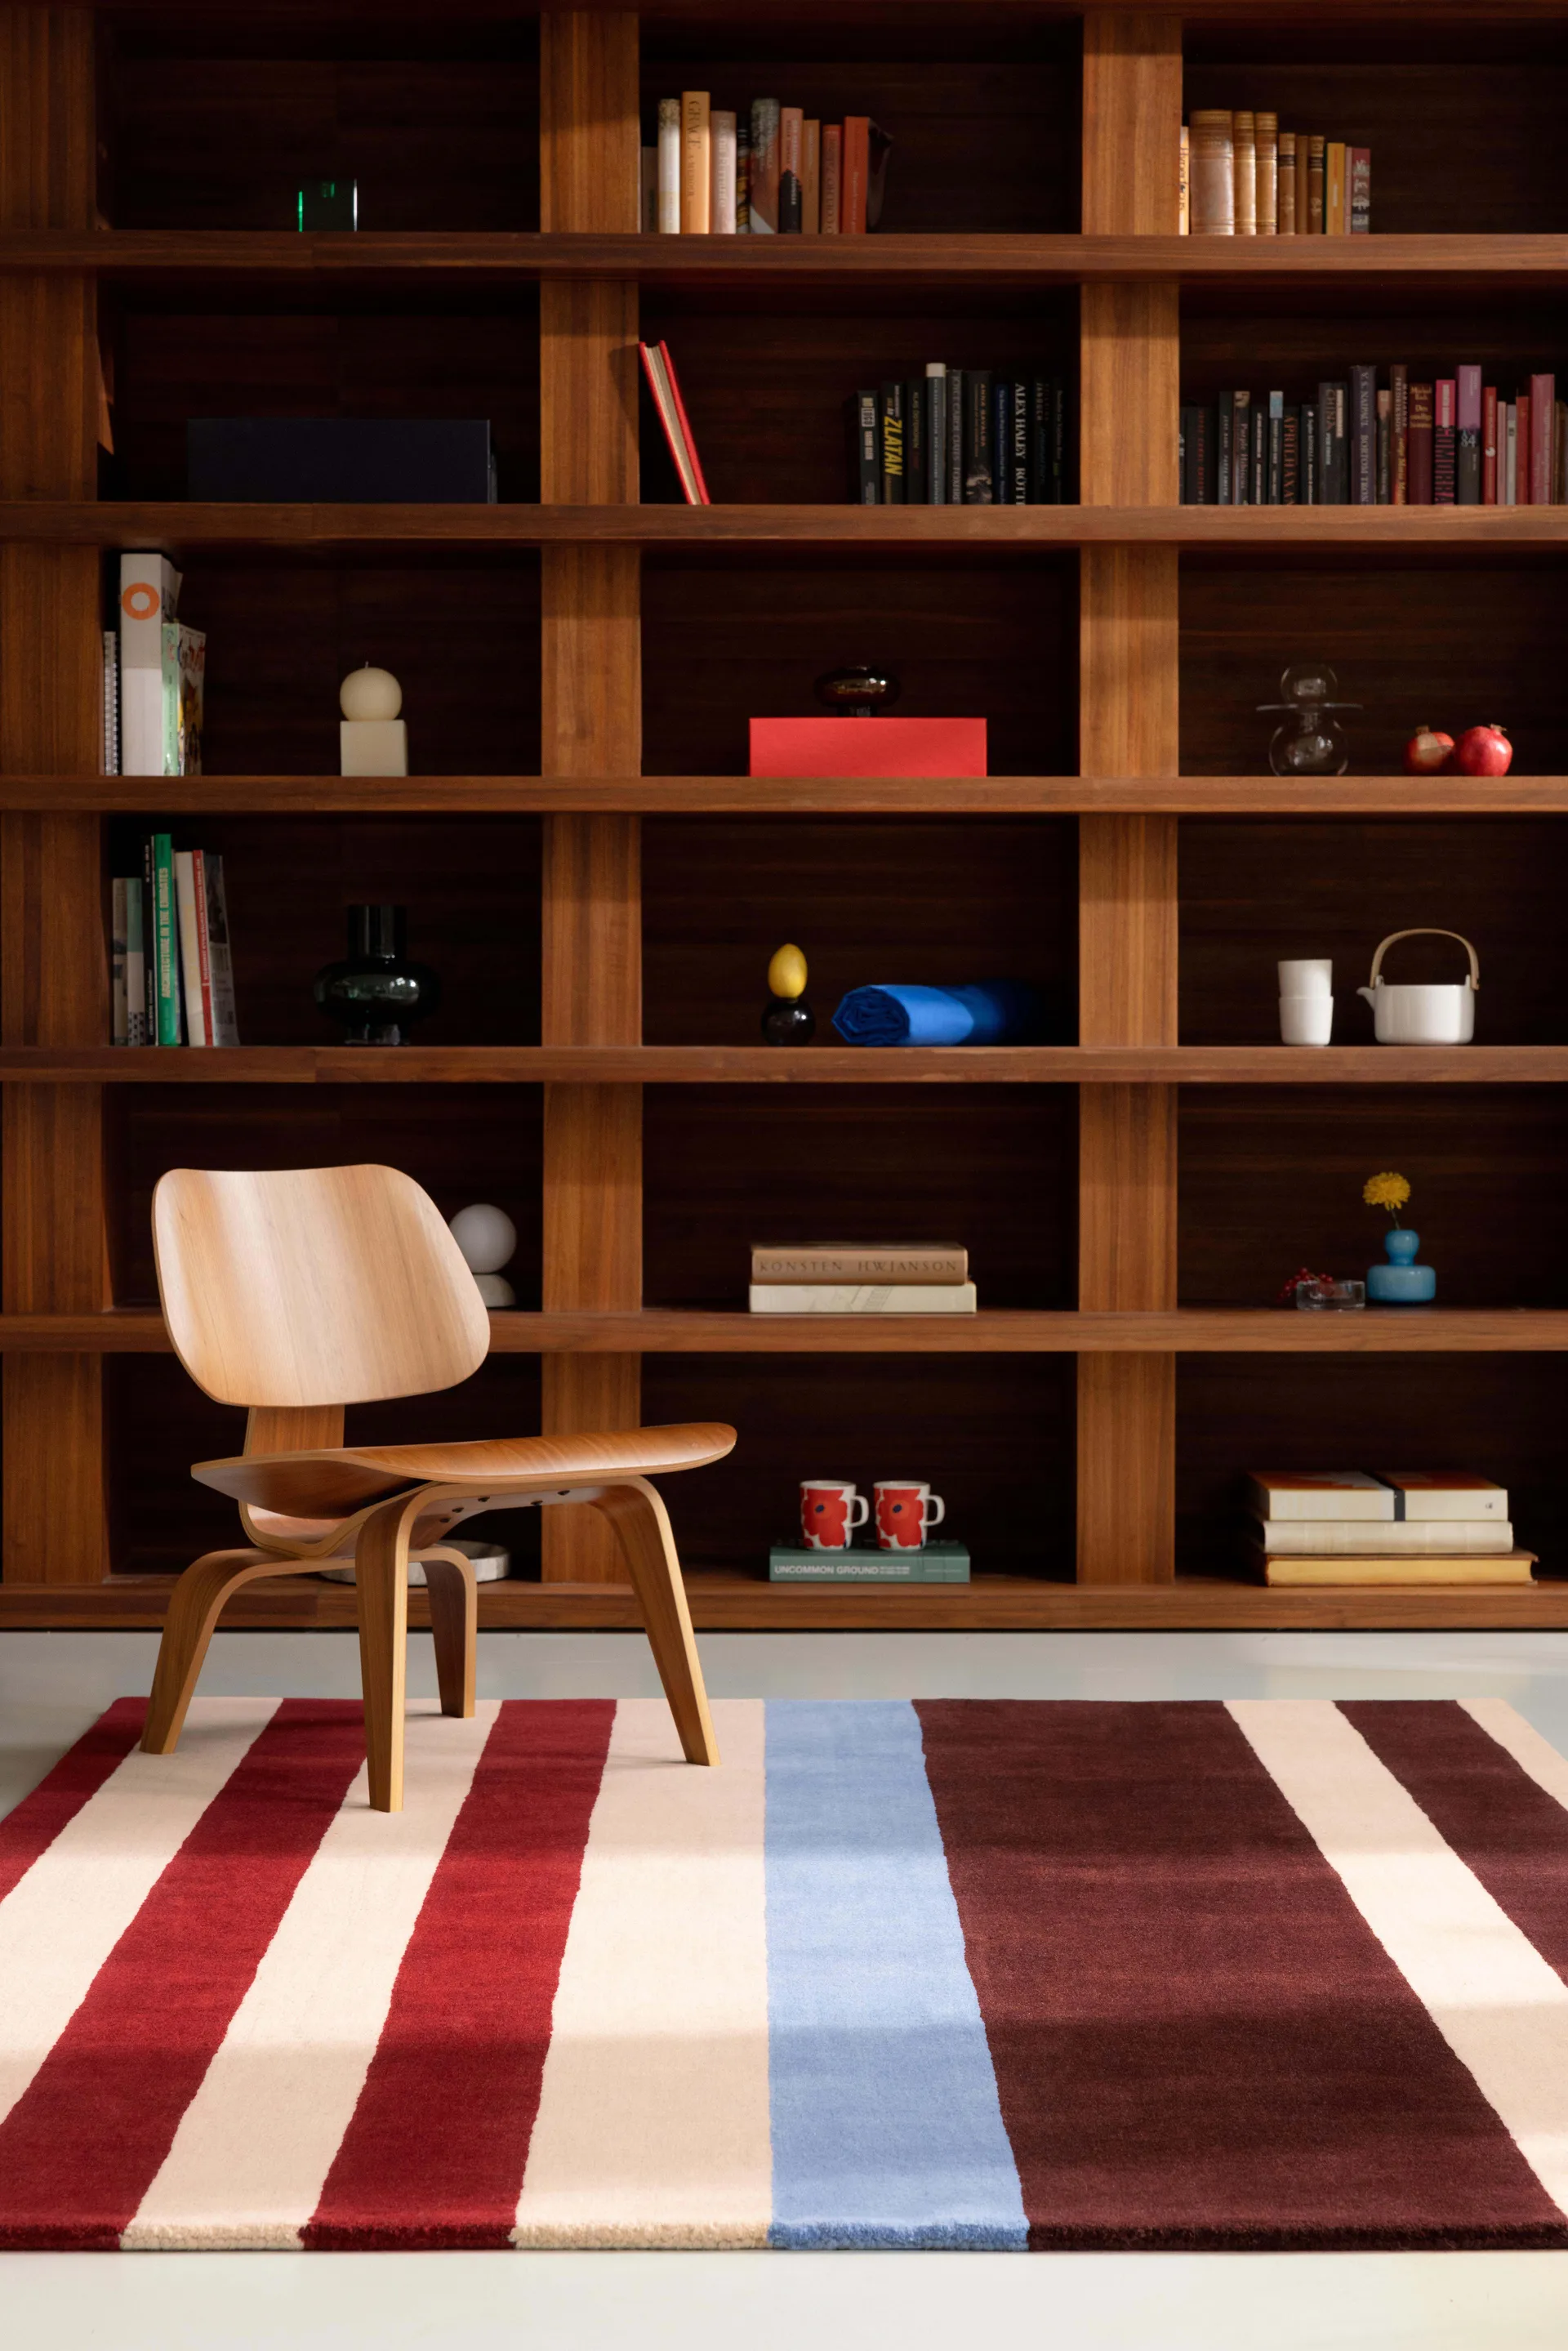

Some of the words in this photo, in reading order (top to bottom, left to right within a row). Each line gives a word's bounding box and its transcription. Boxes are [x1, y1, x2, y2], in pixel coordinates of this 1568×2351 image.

[687, 101, 702, 149] GRACE
[1015, 383, 1026, 416] ALEX
[1361, 390, 1369, 427] NAIPAUL
[884, 416, 902, 476] ZLATAN
[1015, 418, 1026, 459] HALEY
[1240, 423, 1248, 450] Purple
[1361, 434, 1369, 474] BORTOM
[1241, 453, 1249, 489] Hibiscus
[760, 1260, 843, 1272] KONSTEN
[775, 1565, 835, 1575] UNCOMMON
[836, 1565, 879, 1575] GROUND
